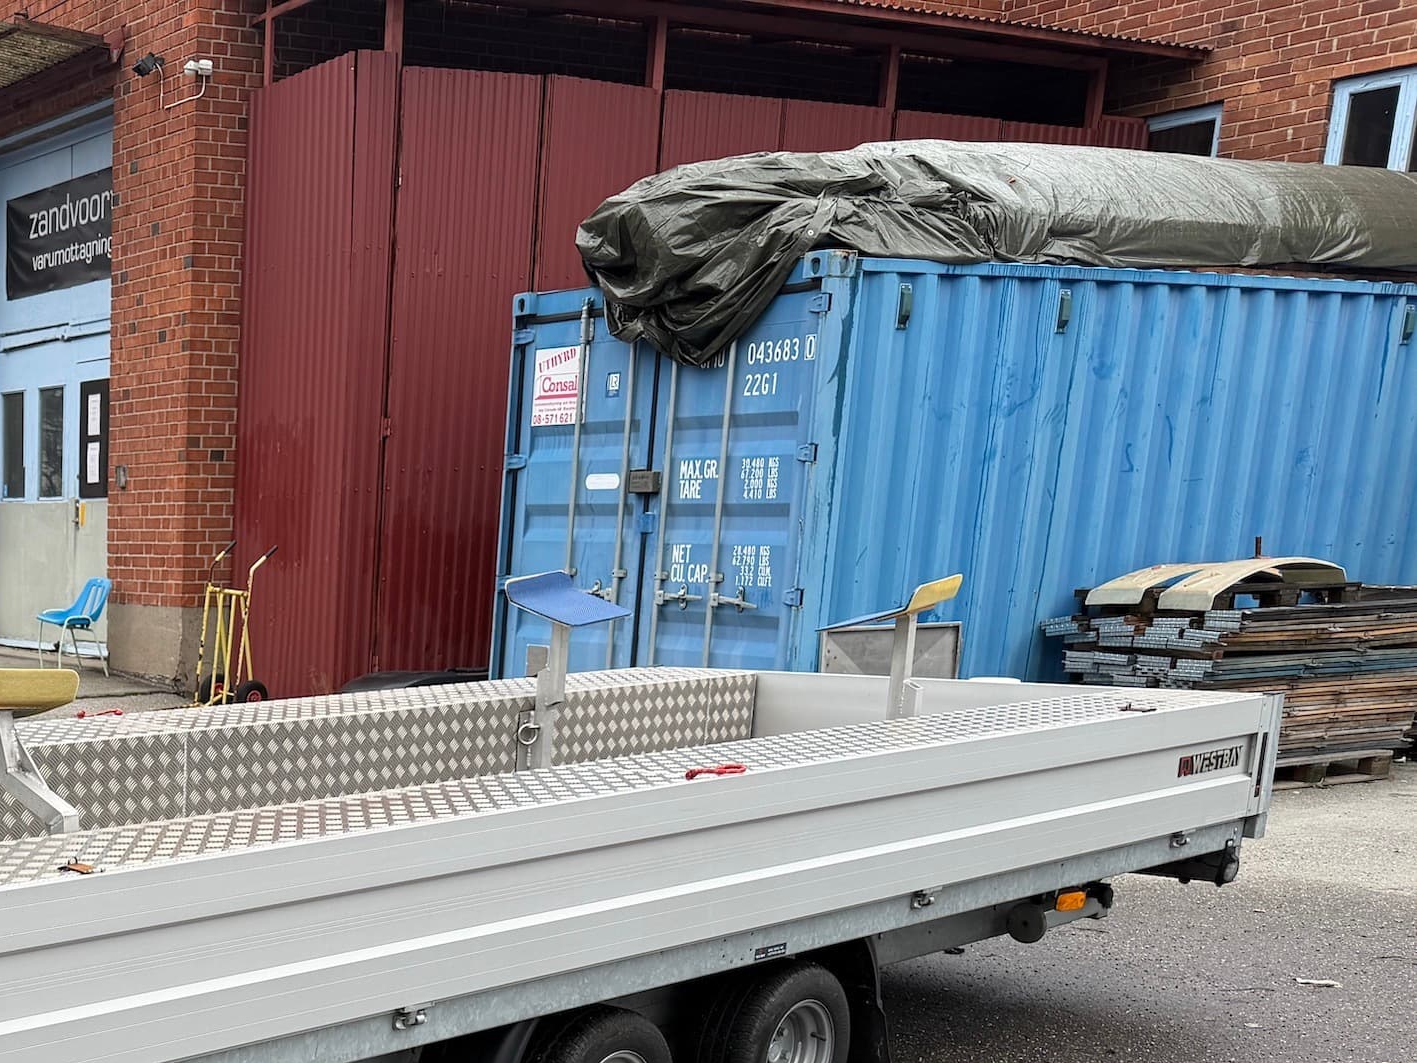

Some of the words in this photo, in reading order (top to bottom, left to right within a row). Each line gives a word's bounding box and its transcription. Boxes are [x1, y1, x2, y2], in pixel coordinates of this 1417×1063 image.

[28, 189, 113, 239] zandvoor
[747, 337, 800, 365] 043683
[806, 335, 816, 359] 0
[743, 372, 778, 396] 22G1
[679, 479, 702, 499] TARE
[672, 544, 692, 563] NET
[1193, 745, 1244, 774] WESTBAY
